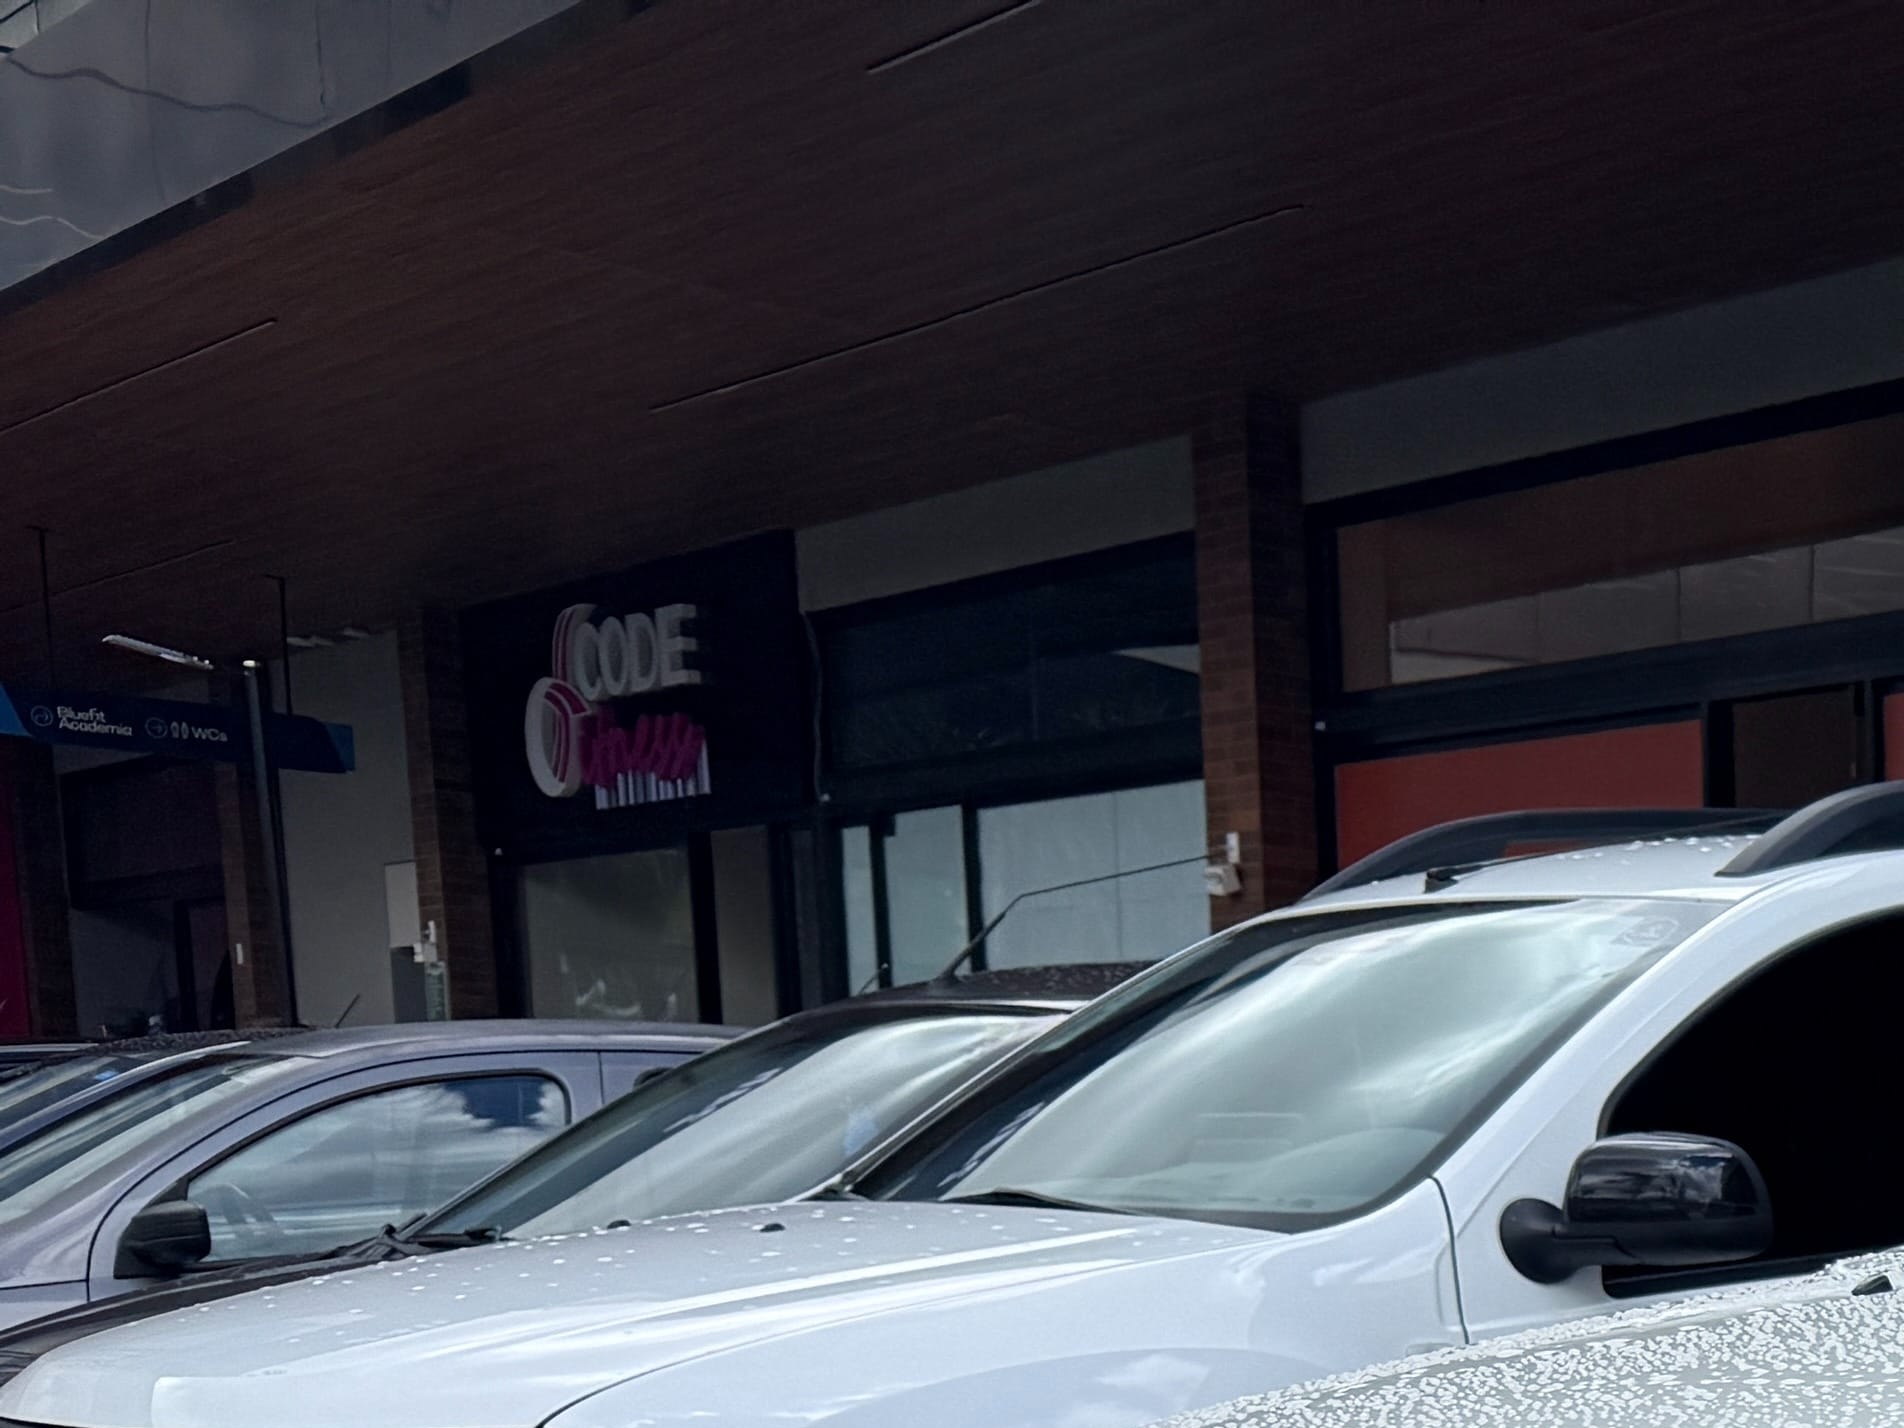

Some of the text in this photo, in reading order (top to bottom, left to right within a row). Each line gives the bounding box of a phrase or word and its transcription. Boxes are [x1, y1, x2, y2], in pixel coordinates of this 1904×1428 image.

[573, 603, 701, 701] CODE
[57, 705, 106, 722] Bluefit
[58, 716, 132, 737] Academia
